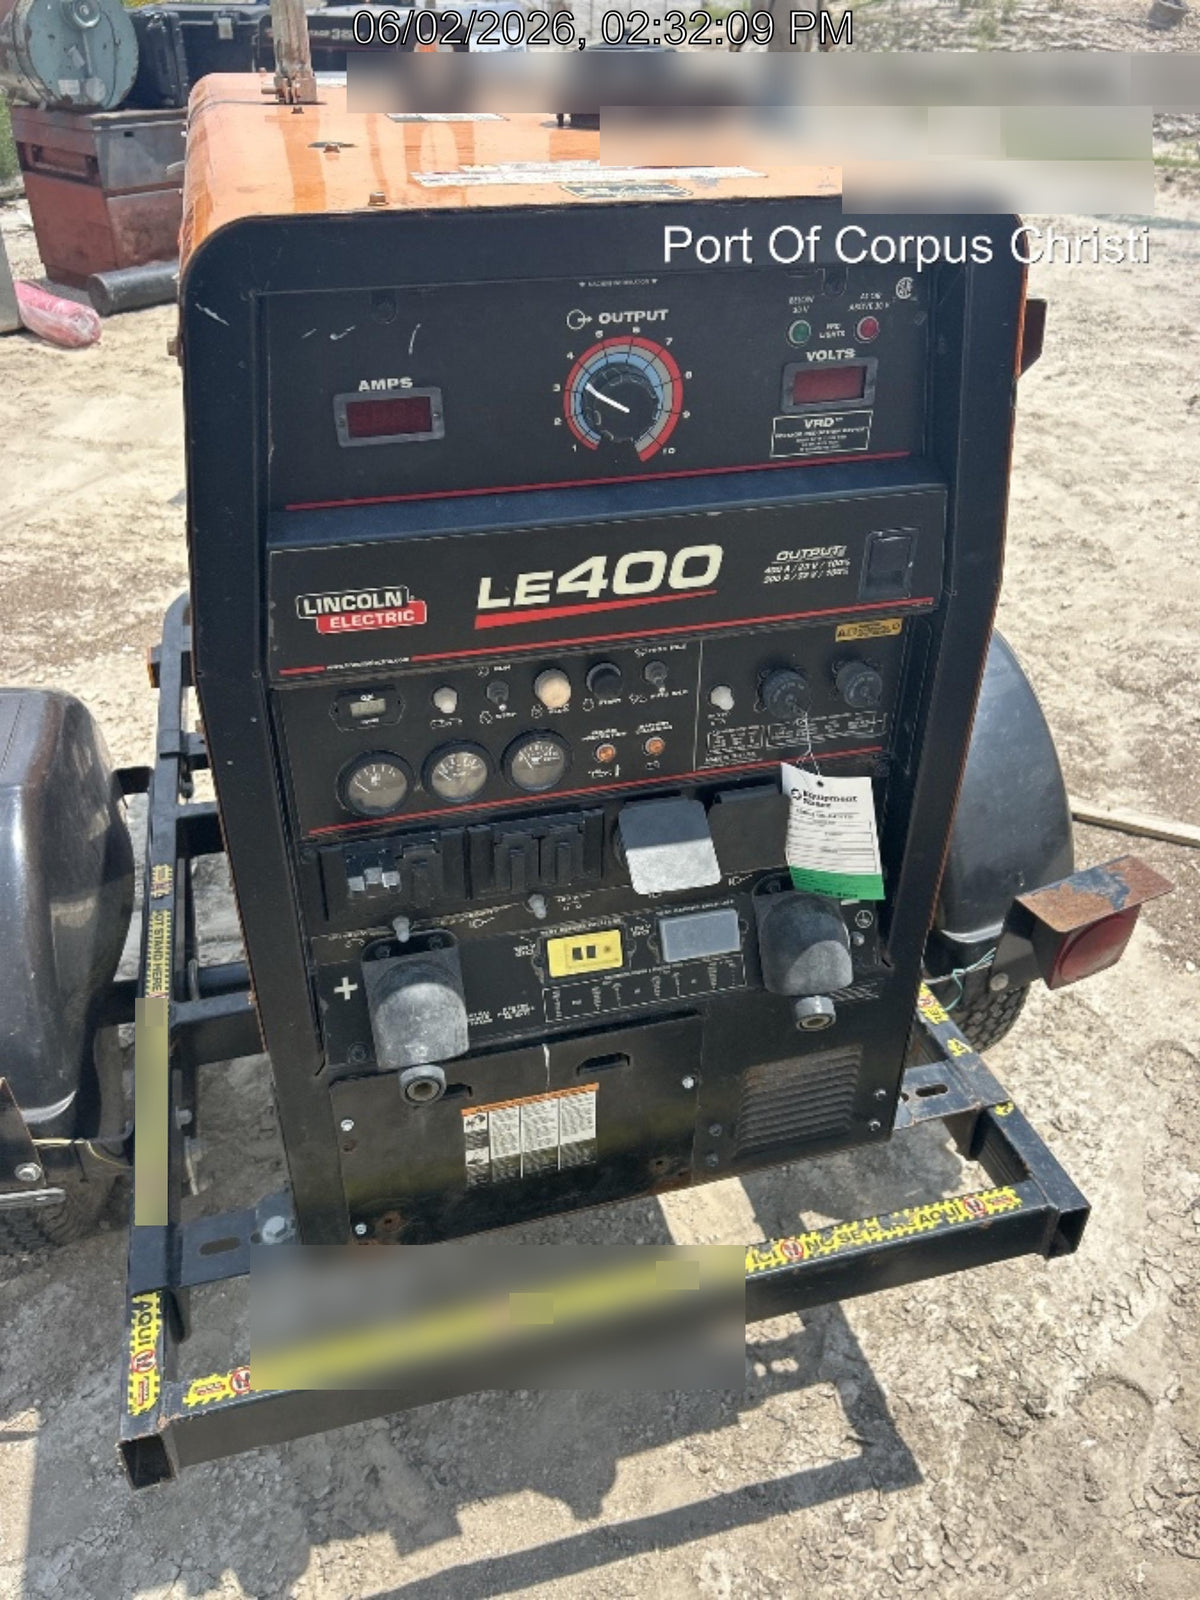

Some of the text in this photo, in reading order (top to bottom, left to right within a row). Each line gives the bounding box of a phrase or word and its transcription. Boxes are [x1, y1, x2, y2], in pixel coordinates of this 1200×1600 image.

[598, 308, 669, 325] OUTPUT
[665, 337, 673, 346] 7
[566, 351, 574, 360] 4
[806, 348, 856, 362] VOLTS
[358, 376, 413, 392] AMPS
[477, 544, 723, 609] LE400
[303, 591, 403, 615] LINCOLN
[330, 610, 415, 629] ELECTRIC
[153, 928, 165, 961] STAND
[152, 963, 164, 992] HERE
[837, 1228, 864, 1244] SE
